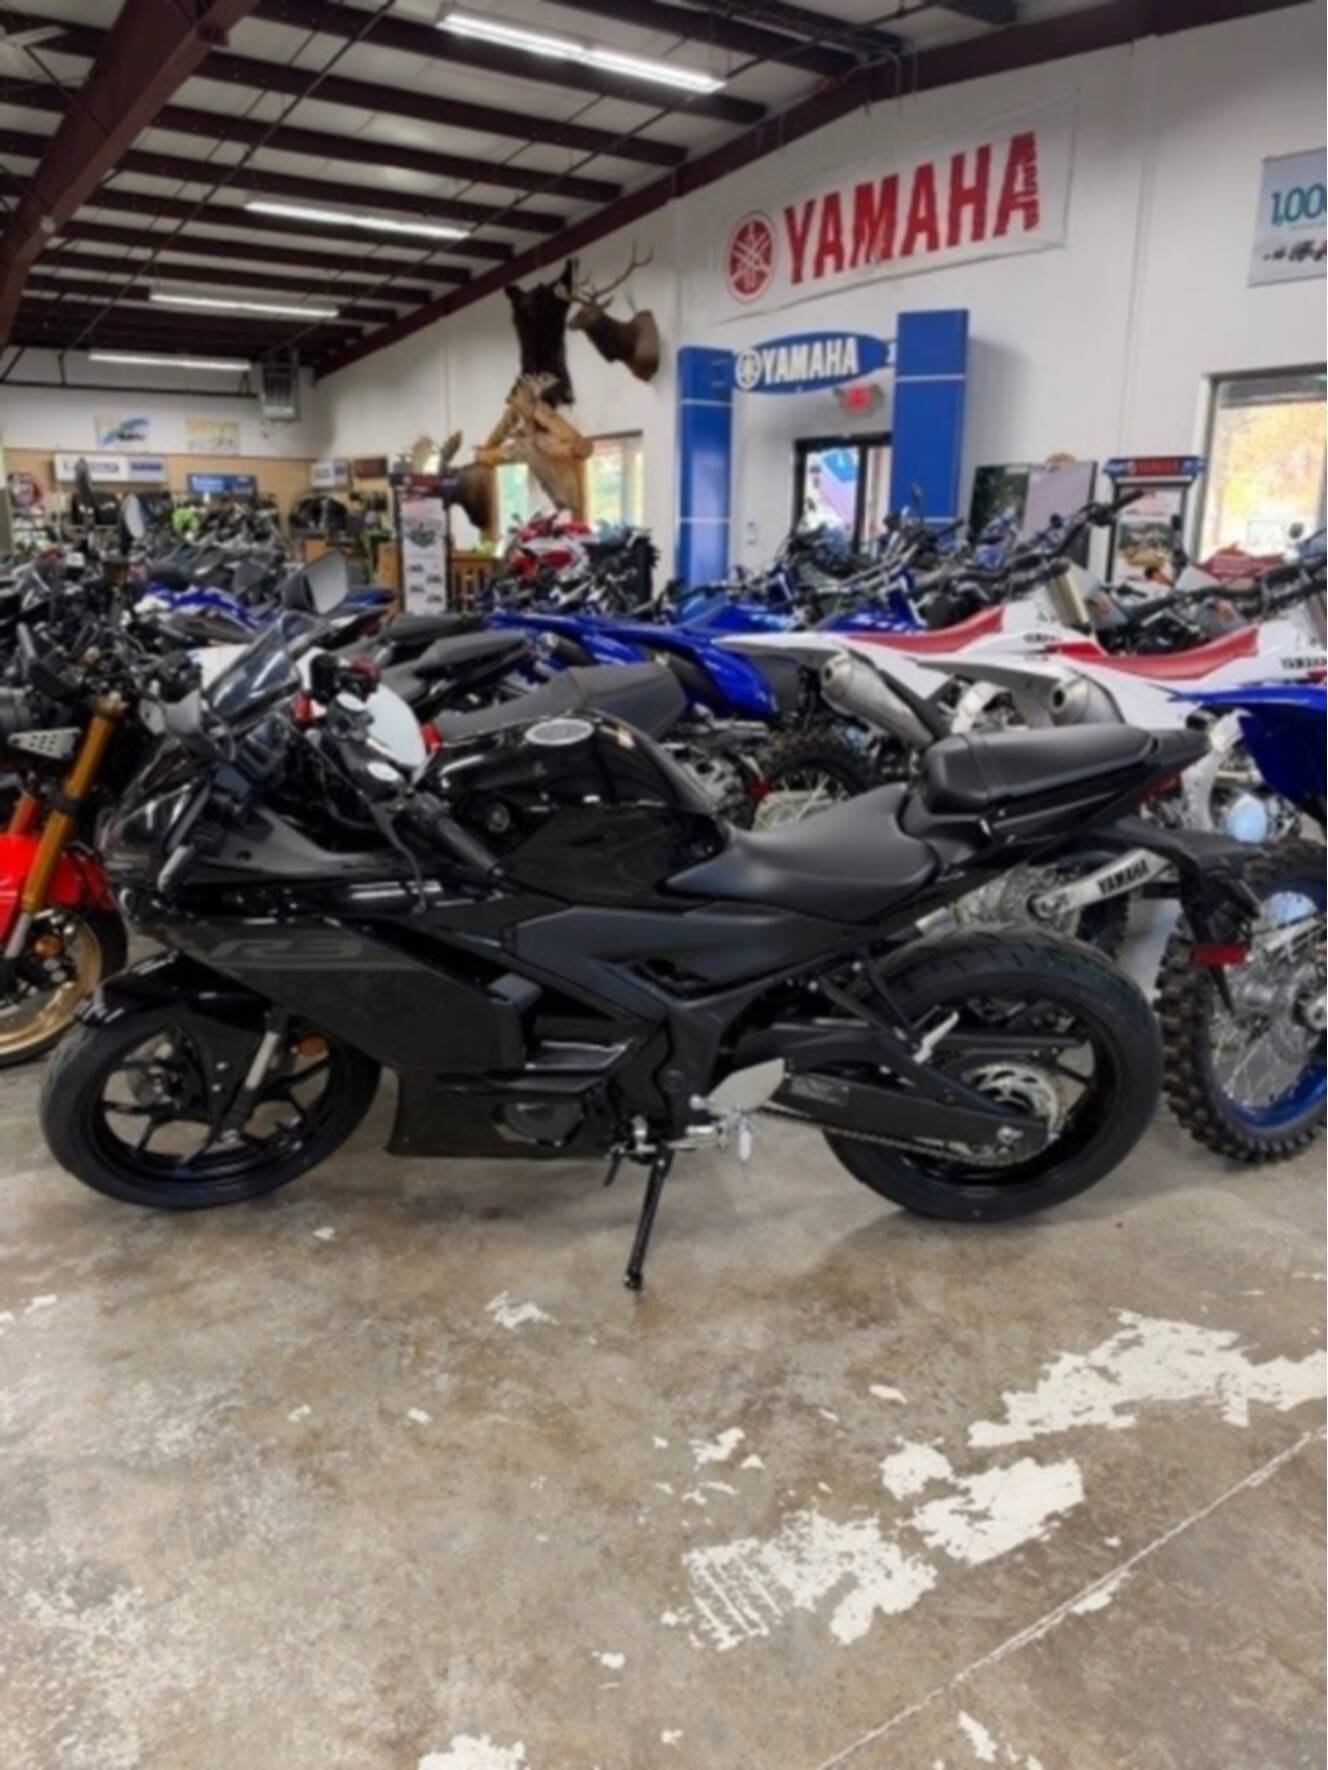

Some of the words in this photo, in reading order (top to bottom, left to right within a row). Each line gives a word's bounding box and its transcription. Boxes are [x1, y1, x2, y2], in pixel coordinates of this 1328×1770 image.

[784, 131, 1039, 285] YAMAHA
[762, 337, 860, 385] YAMAHA
[1097, 859, 1149, 896] YAMAHA
